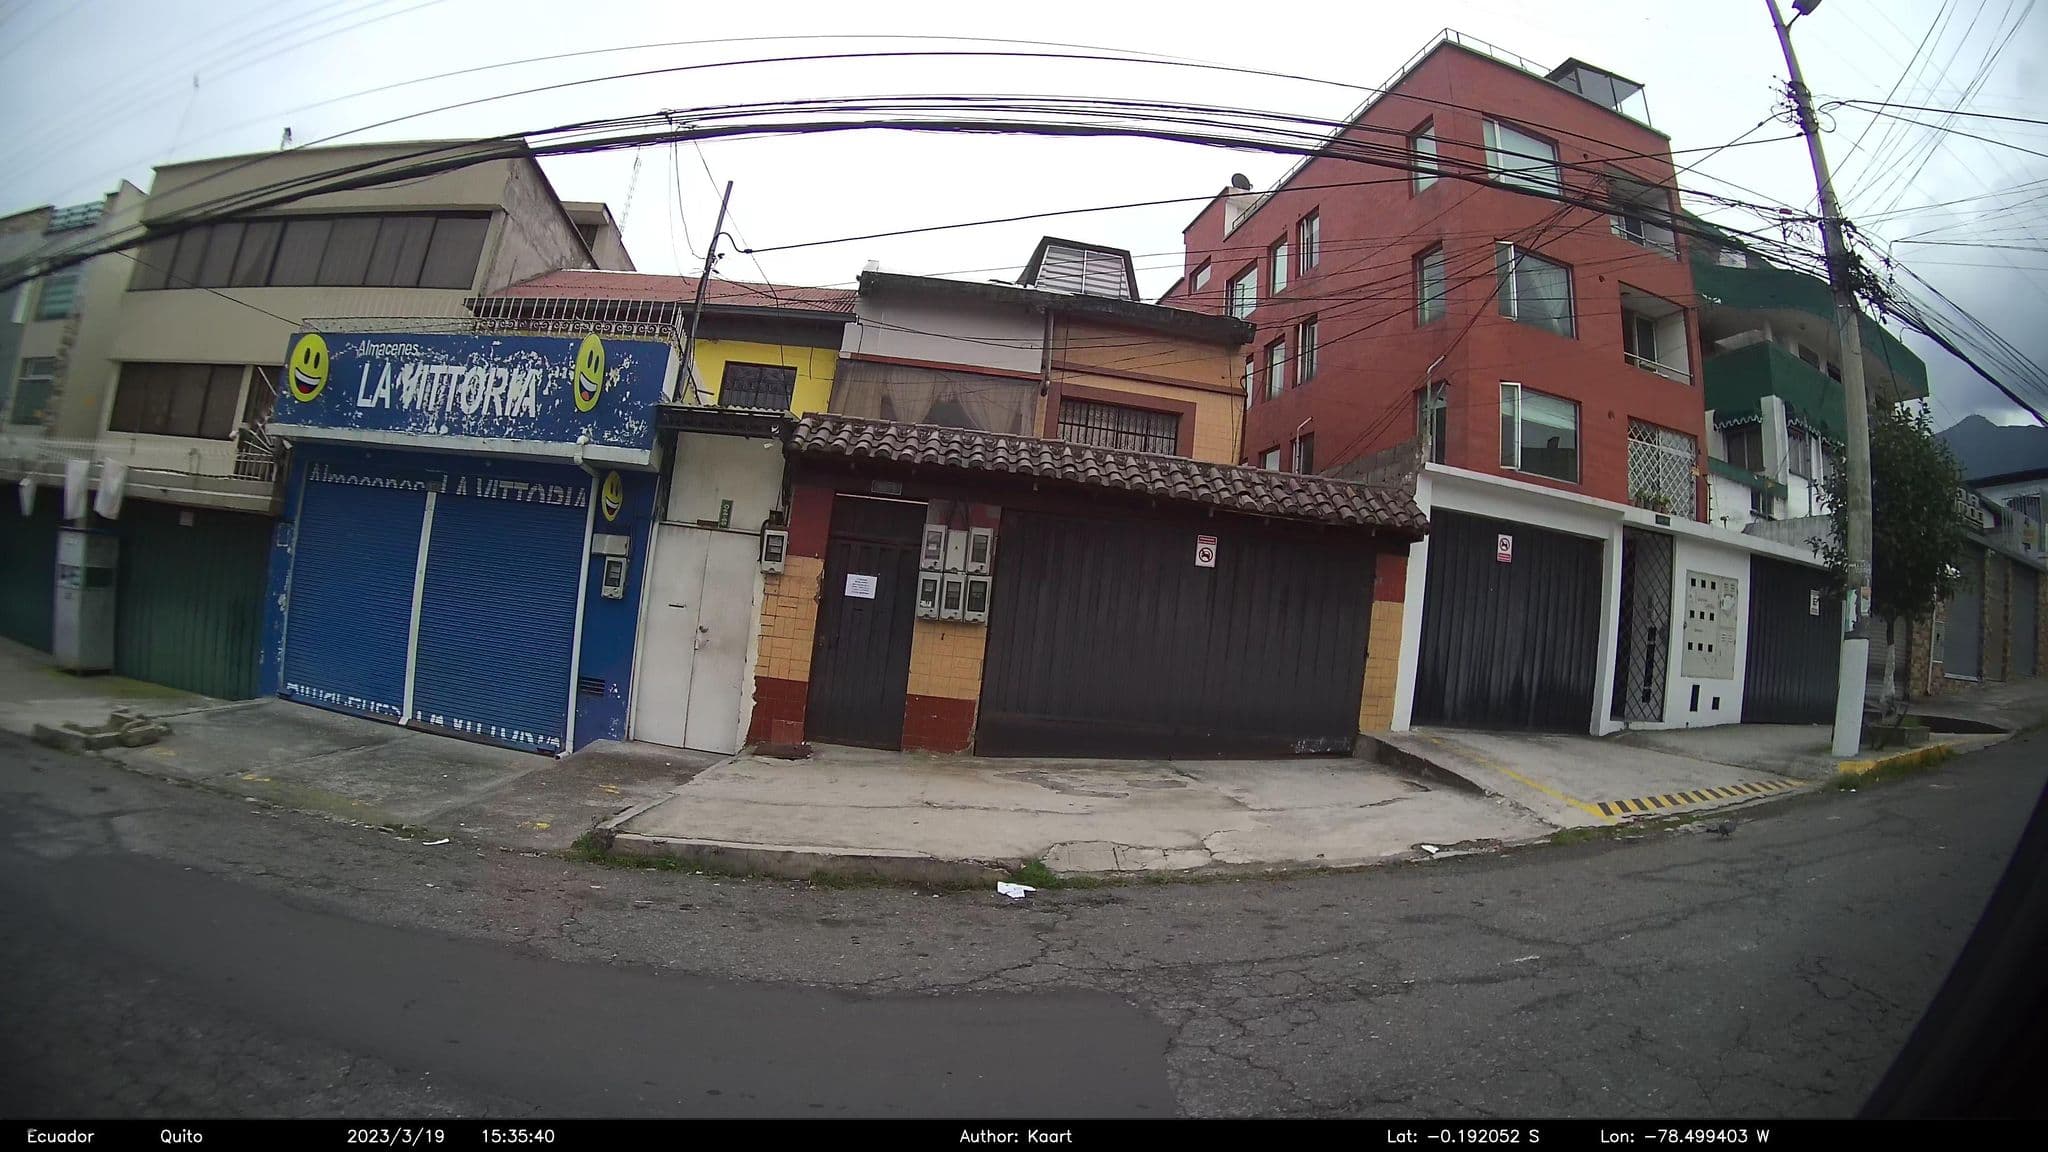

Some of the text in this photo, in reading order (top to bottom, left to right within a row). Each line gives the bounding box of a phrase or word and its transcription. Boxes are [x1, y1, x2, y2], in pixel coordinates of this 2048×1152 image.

[357, 340, 419, 357] Almacenes
[357, 361, 538, 418] LA VITTORIA
